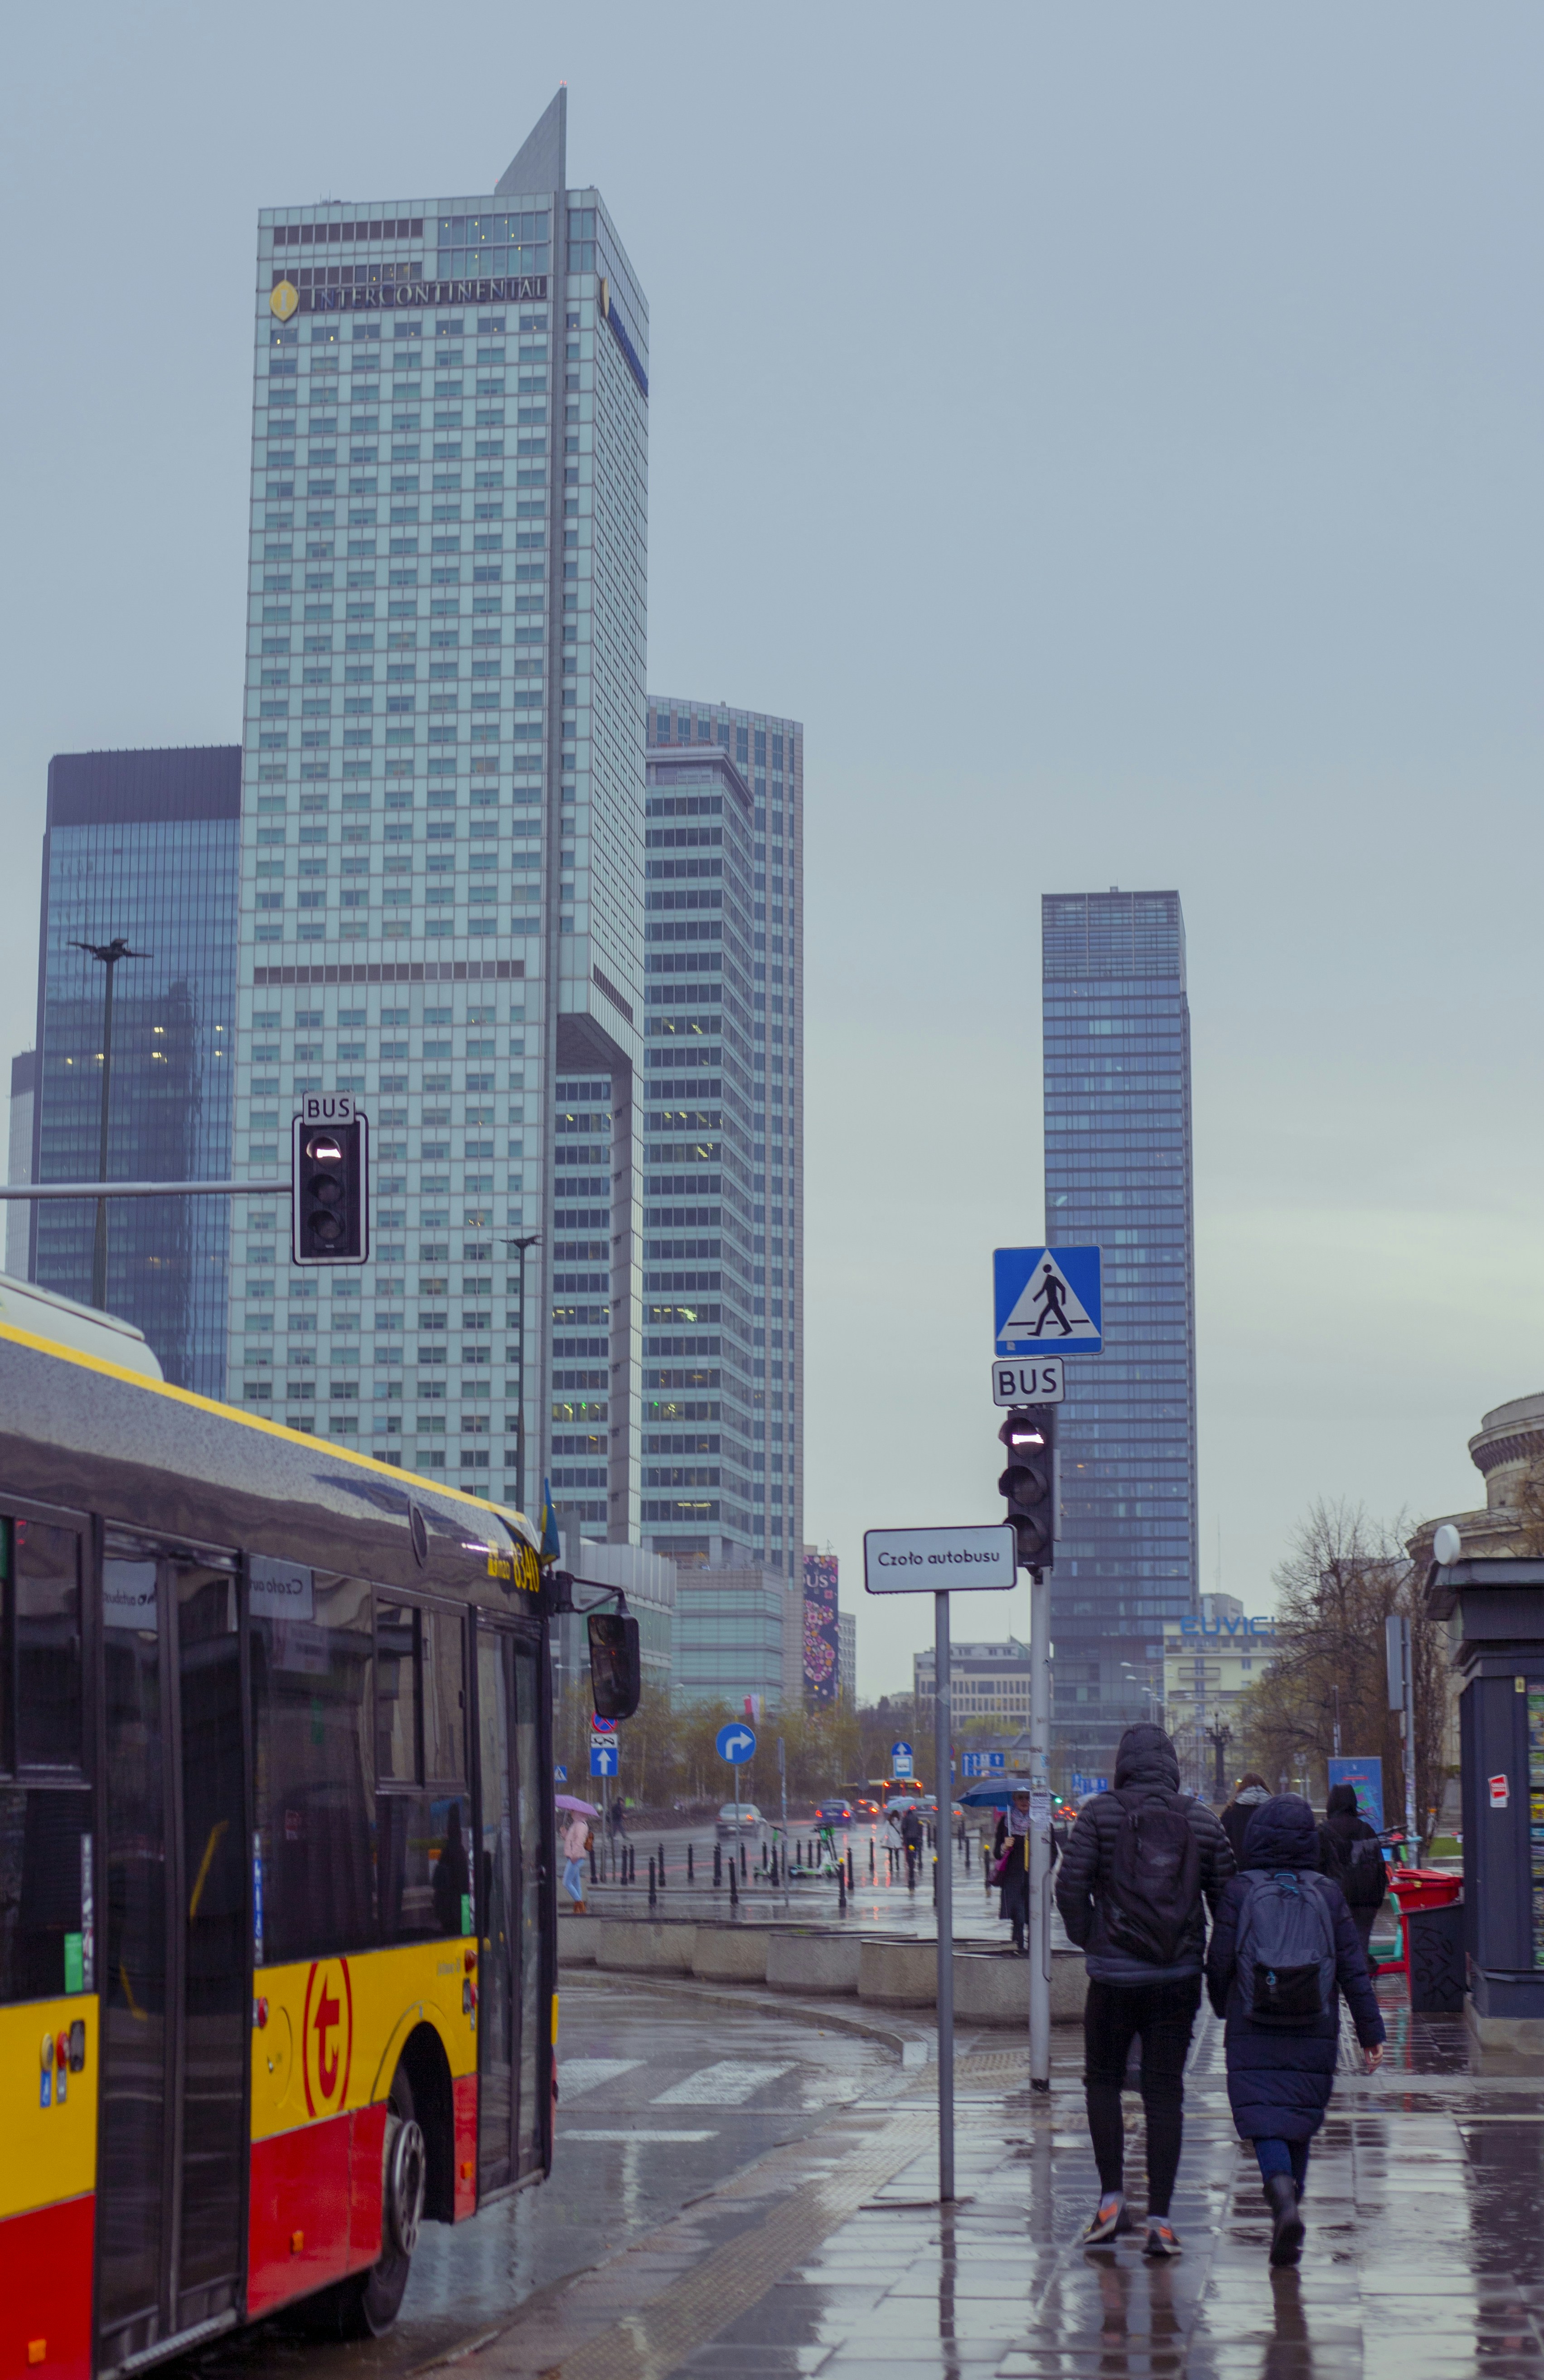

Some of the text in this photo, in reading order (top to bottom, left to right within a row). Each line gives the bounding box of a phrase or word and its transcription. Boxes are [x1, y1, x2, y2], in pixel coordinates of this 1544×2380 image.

[310, 278, 546, 311] INTERCONTINENTAL
[308, 1098, 350, 1118] BUS
[998, 1368, 1056, 1396] BUS
[510, 1541, 540, 1593] 8340
[878, 1549, 1000, 1566] Czoło autobusu
